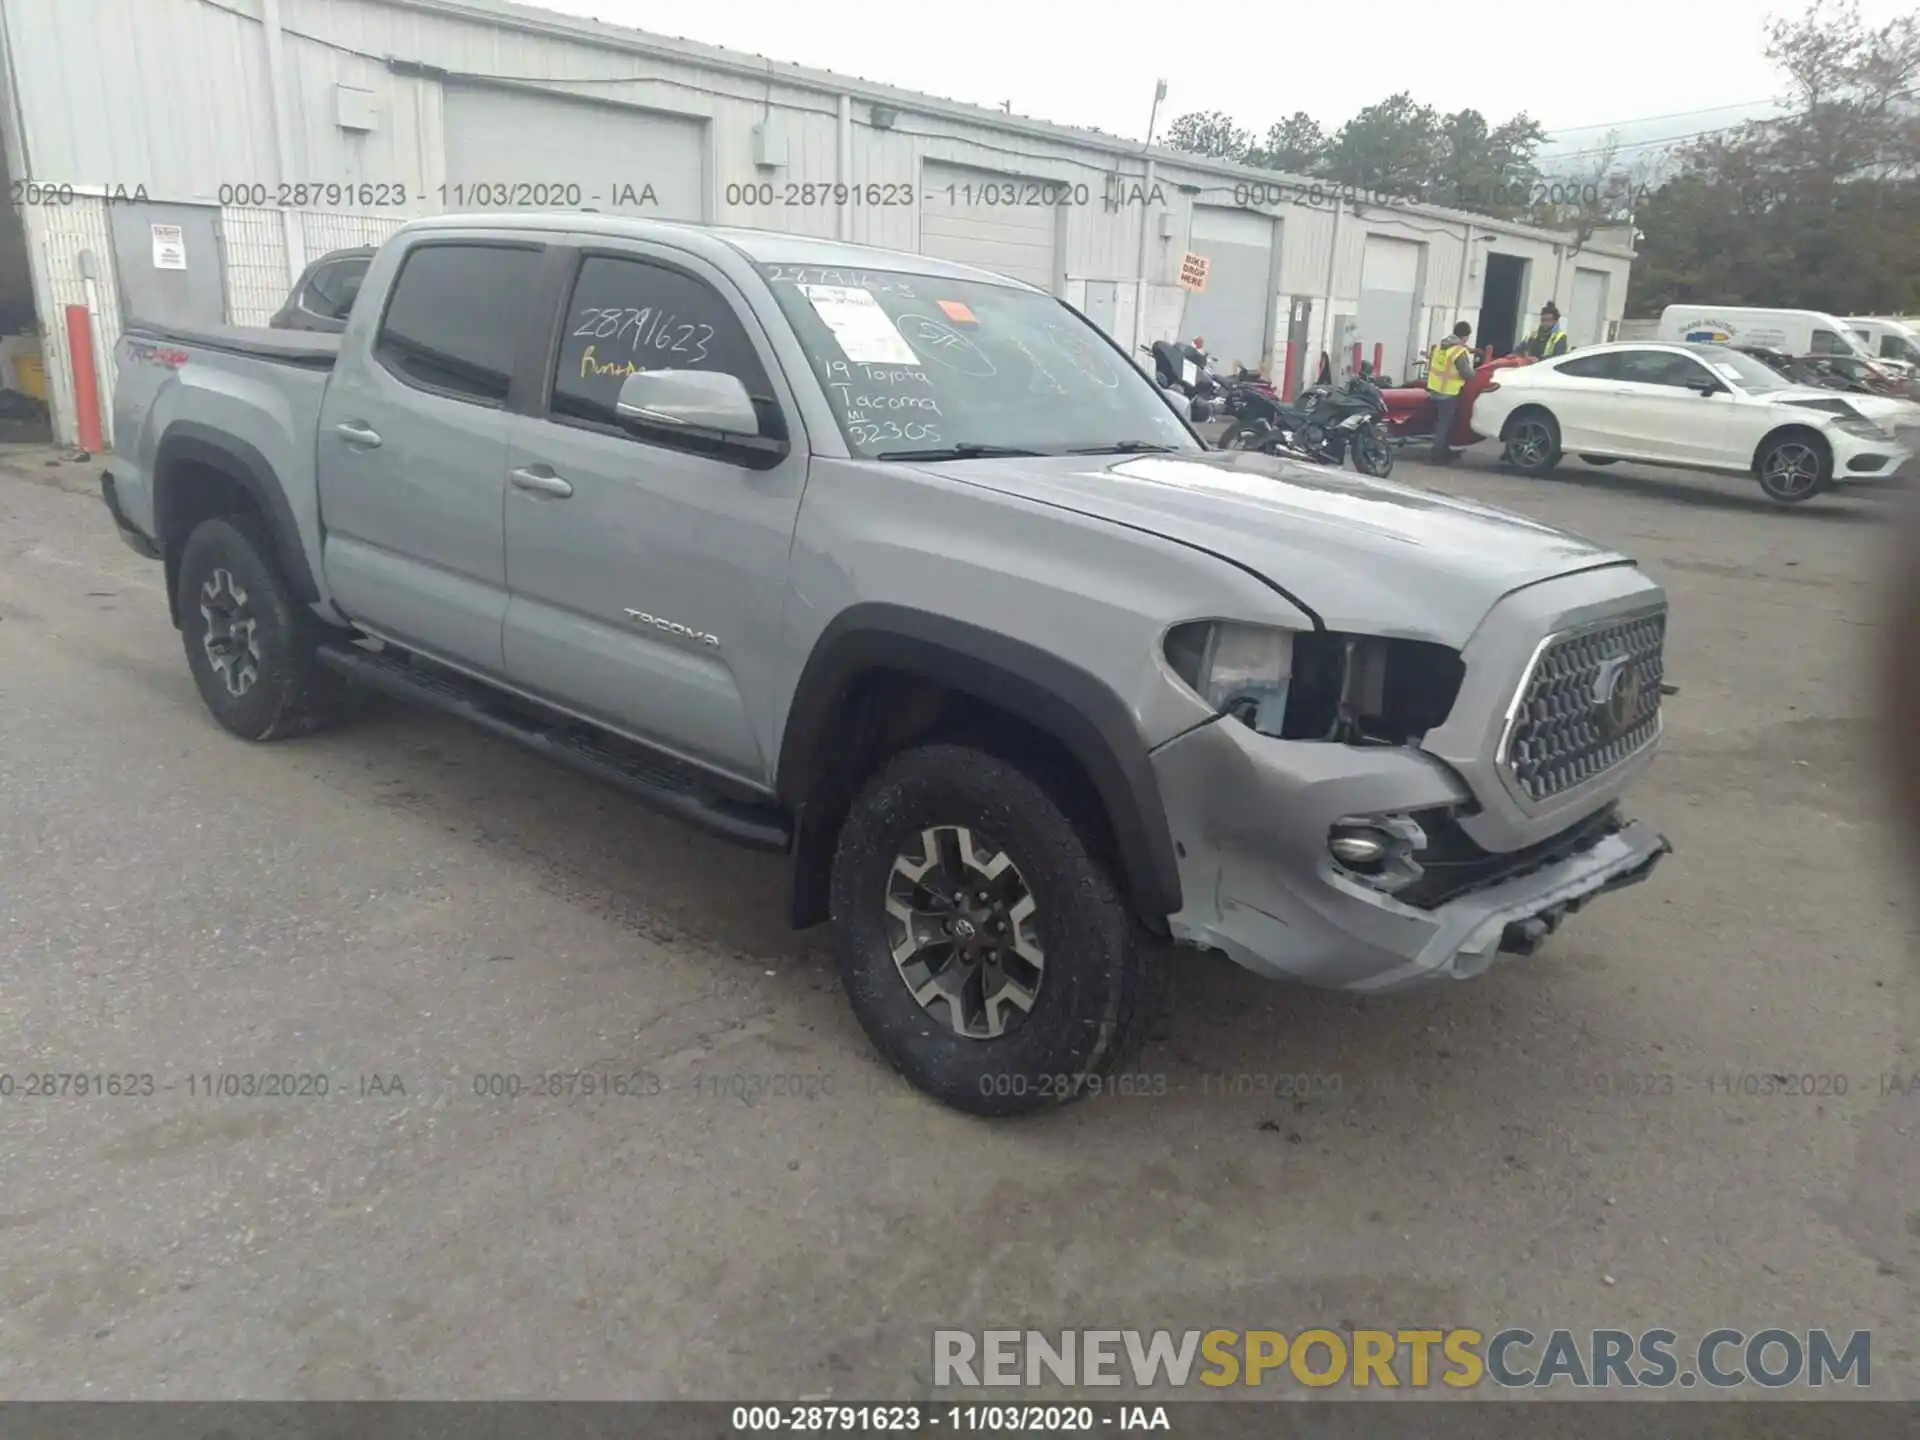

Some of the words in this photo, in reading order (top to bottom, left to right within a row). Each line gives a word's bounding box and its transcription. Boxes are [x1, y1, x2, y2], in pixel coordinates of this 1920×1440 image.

[572, 307, 715, 364] 28791623
[855, 361, 934, 388] Toyota
[829, 382, 944, 418] Tacoma
